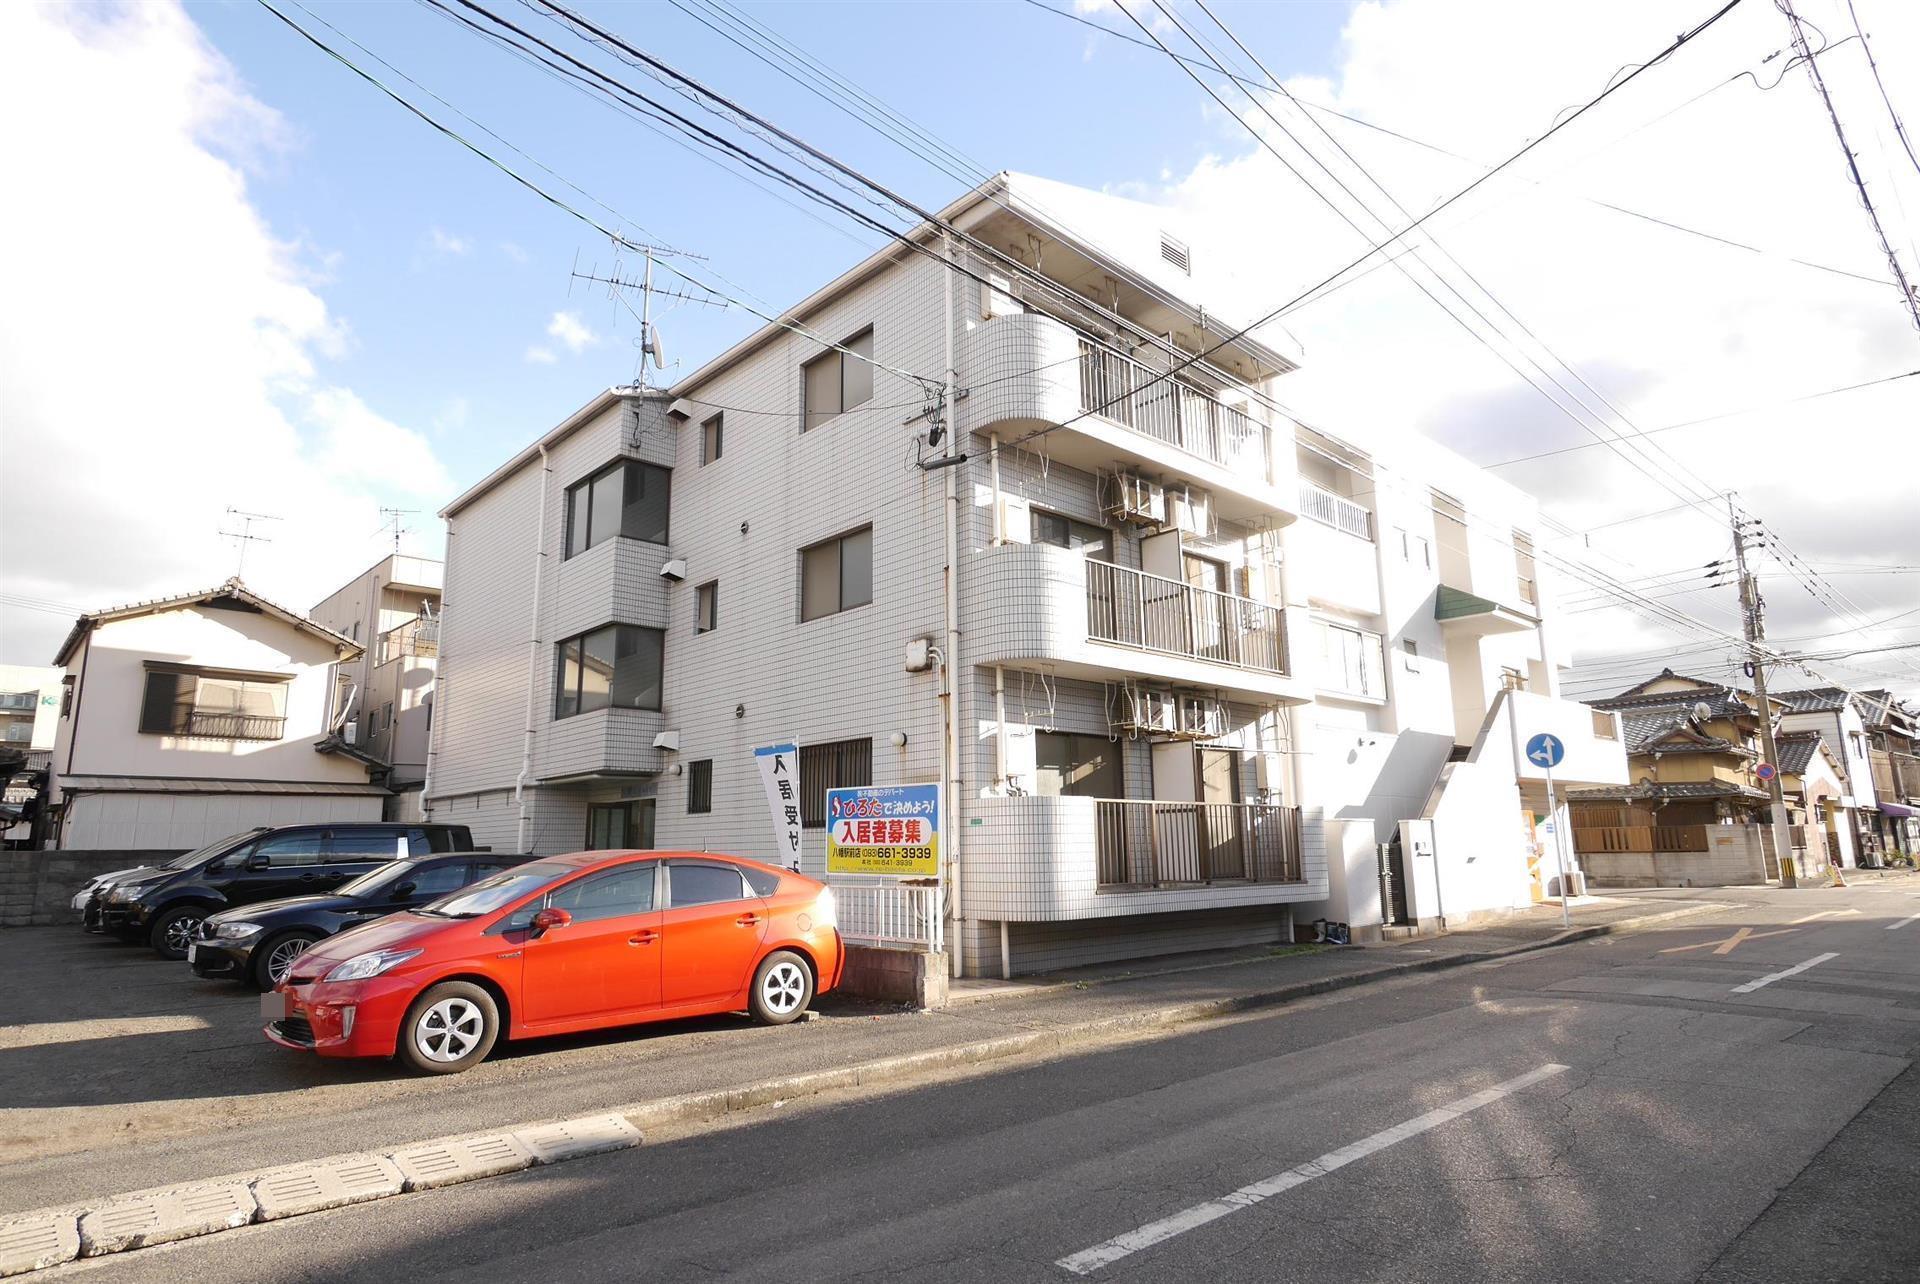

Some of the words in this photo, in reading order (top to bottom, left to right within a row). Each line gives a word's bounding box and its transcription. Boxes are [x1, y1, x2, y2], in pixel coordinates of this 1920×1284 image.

[841, 819, 921, 844] 入居者募集
